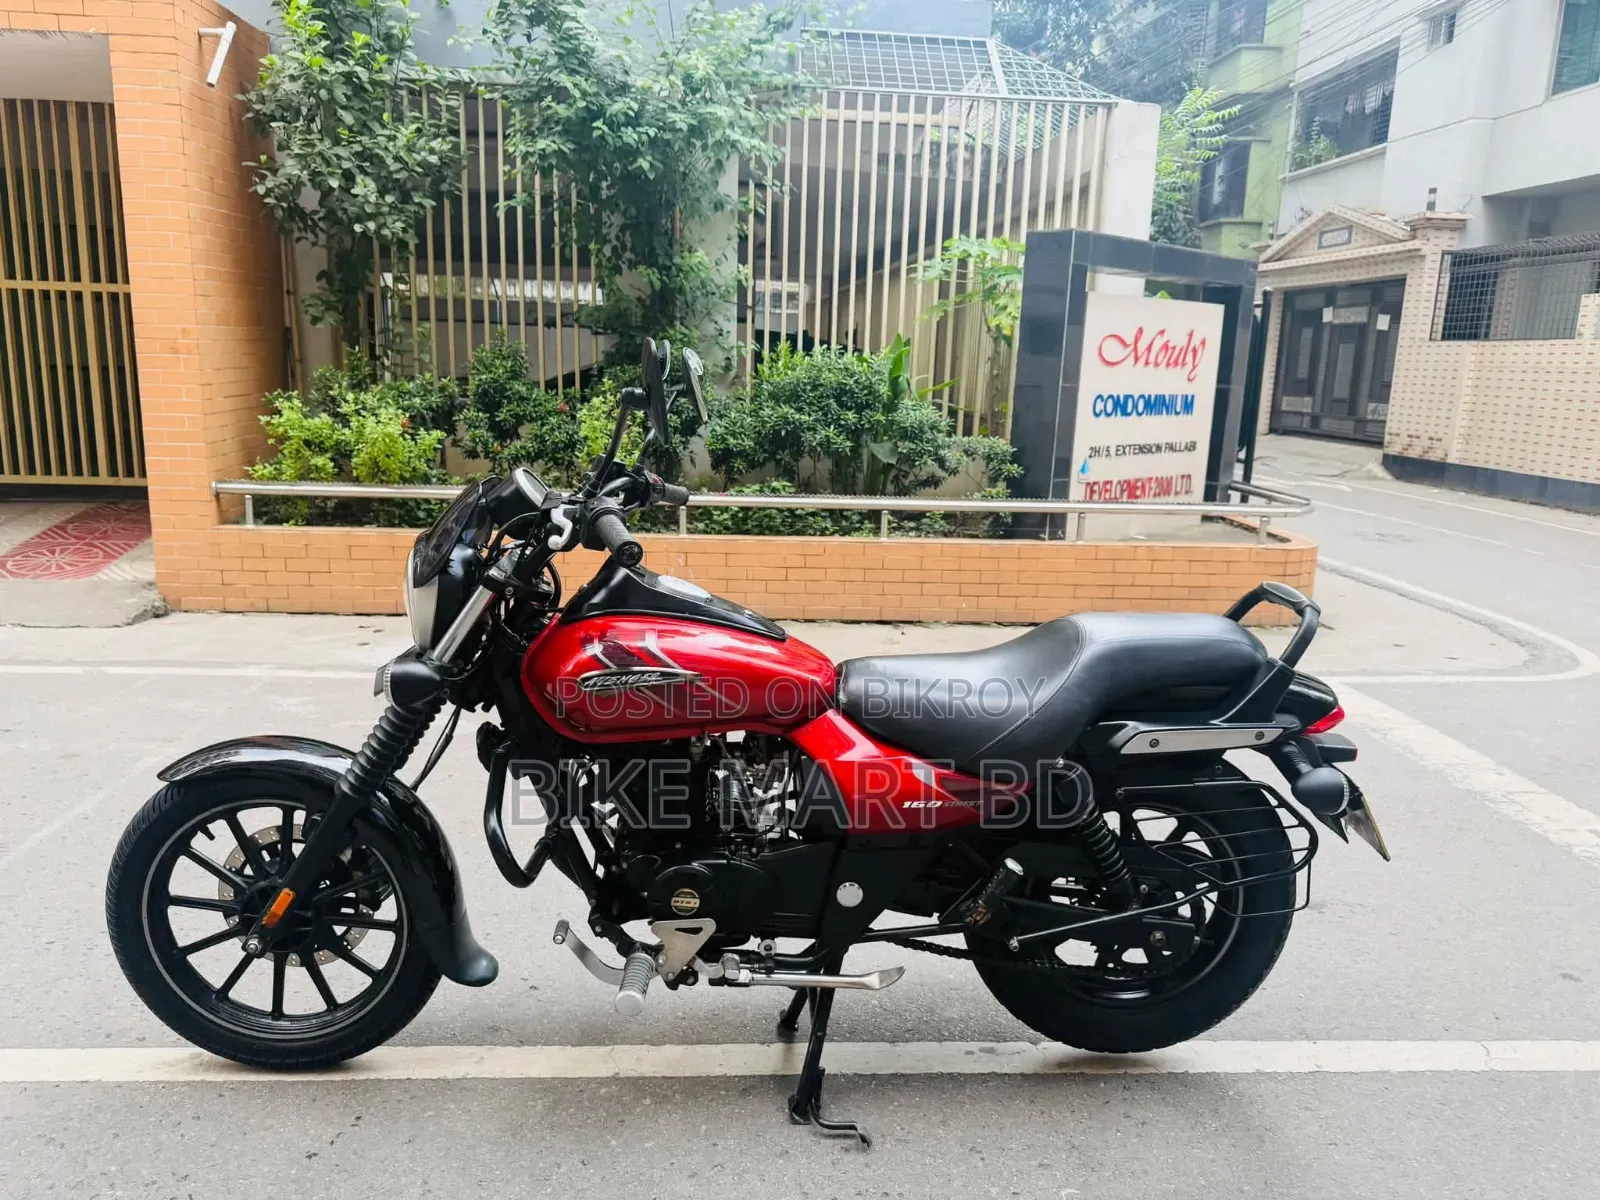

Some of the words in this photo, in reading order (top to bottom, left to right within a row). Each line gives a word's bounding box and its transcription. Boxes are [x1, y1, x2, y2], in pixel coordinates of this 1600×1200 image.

[1097, 326, 1207, 383] Mouly
[1092, 393, 1196, 419] CONDOMINIUM
[1115, 443, 1162, 457] EXTENSION
[1164, 441, 1197, 453] PALLABI
[1174, 474, 1193, 496] LTD.
[583, 672, 663, 688] AVENGER
[902, 800, 943, 809] 160
[943, 800, 985, 808] STREET
